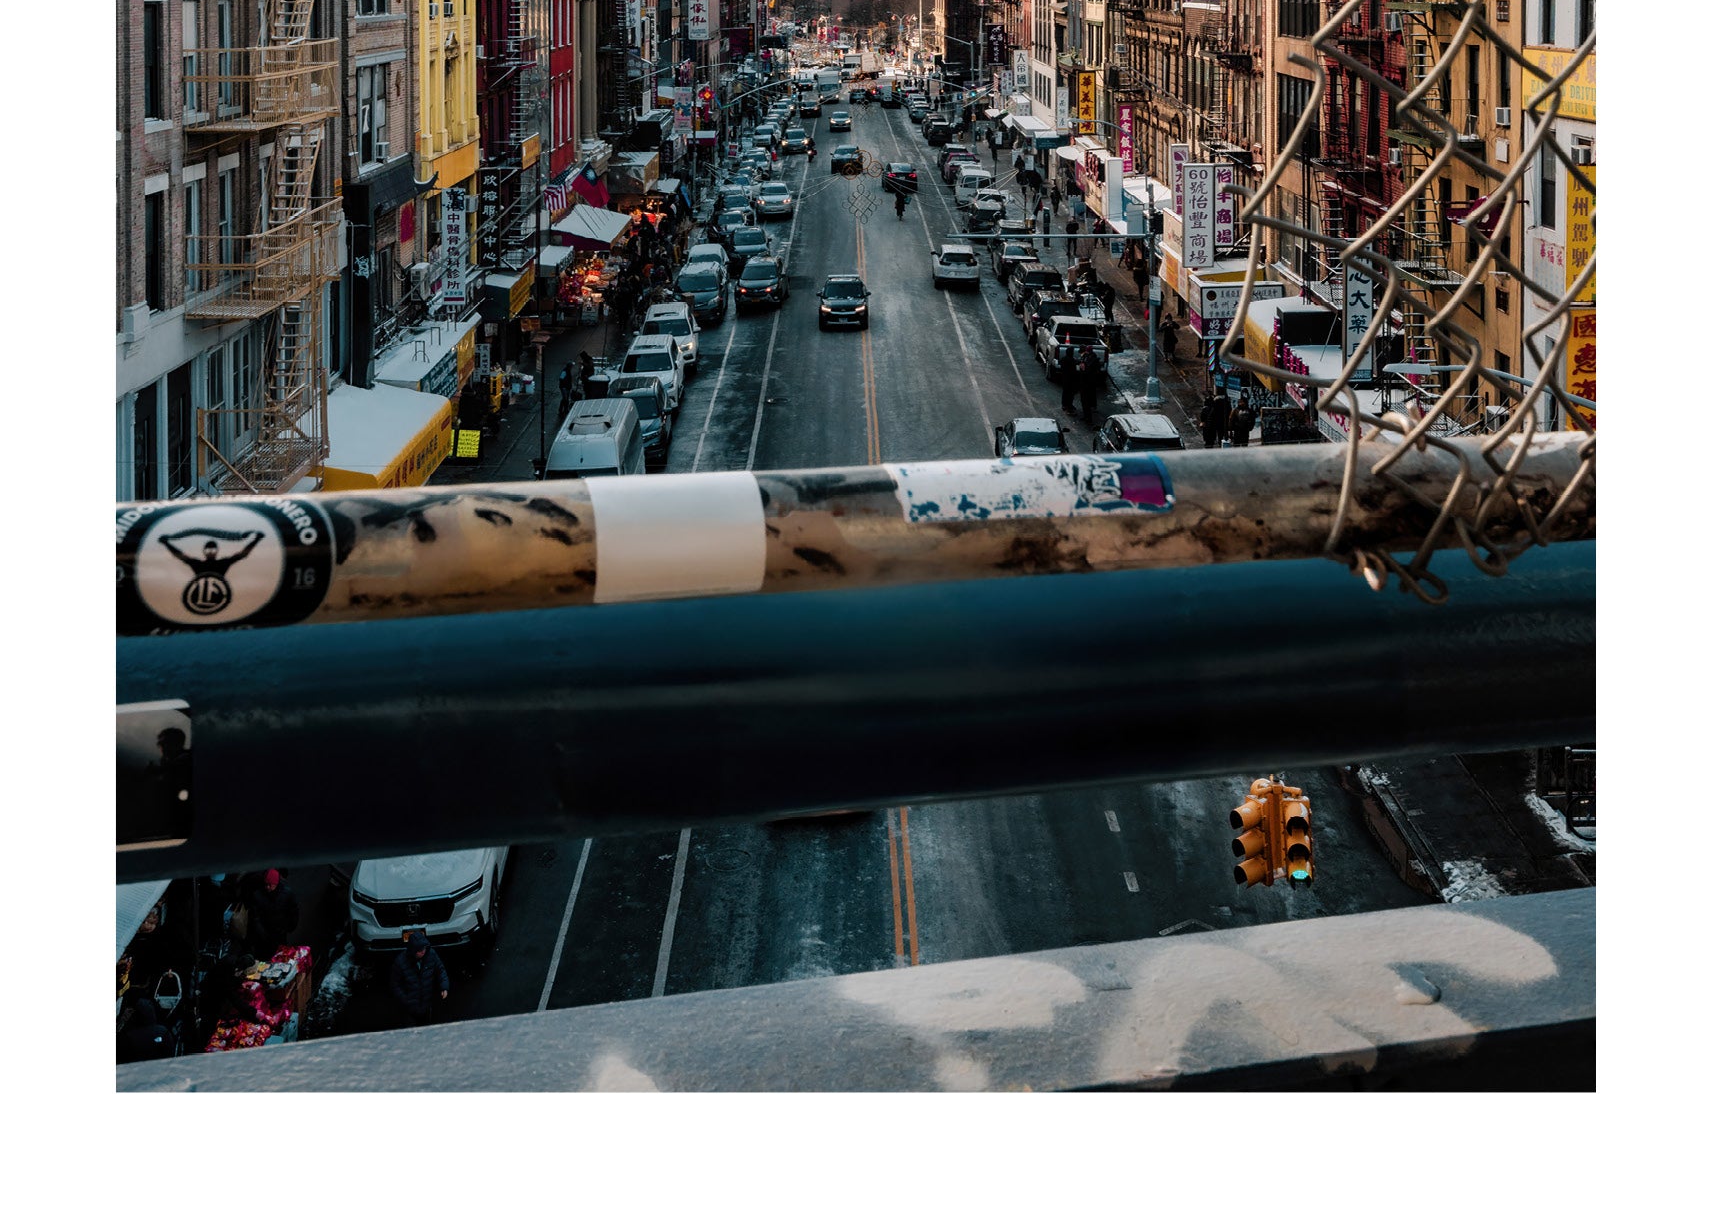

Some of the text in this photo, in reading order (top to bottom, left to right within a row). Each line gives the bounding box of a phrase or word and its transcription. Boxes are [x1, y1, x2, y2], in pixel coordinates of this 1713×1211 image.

[446, 190, 461, 290] 中醫骨傷科診所
[294, 567, 316, 586] 16
